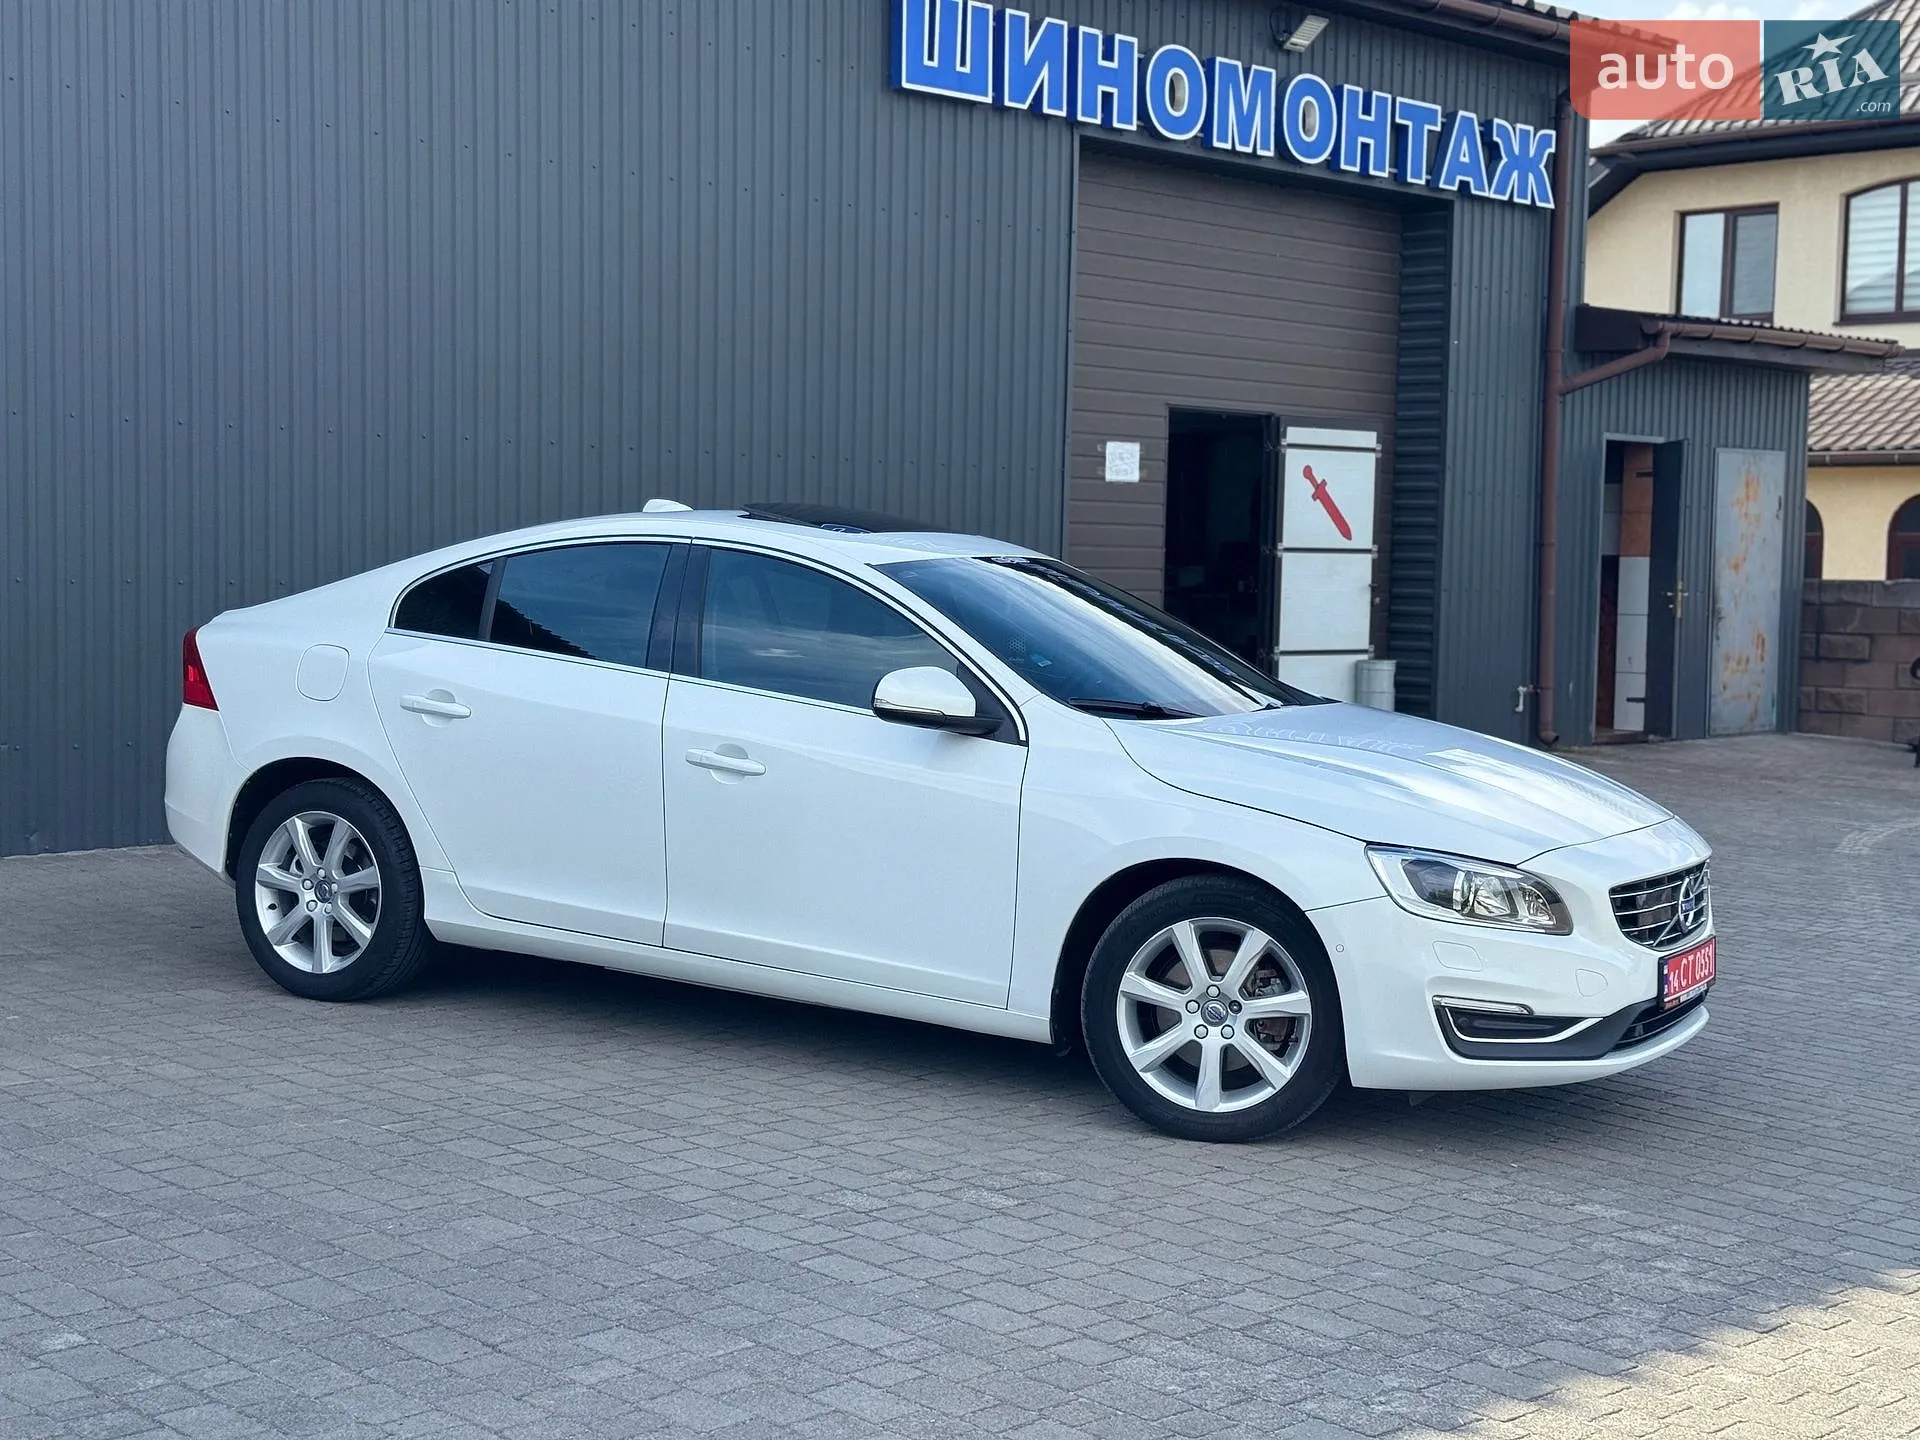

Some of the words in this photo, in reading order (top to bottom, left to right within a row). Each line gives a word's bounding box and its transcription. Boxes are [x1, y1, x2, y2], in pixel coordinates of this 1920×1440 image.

[897, 0, 1556, 210] ШИНОМОНТАЖ
[1669, 969, 1679, 994] 14
[1680, 954, 1694, 988] CT
